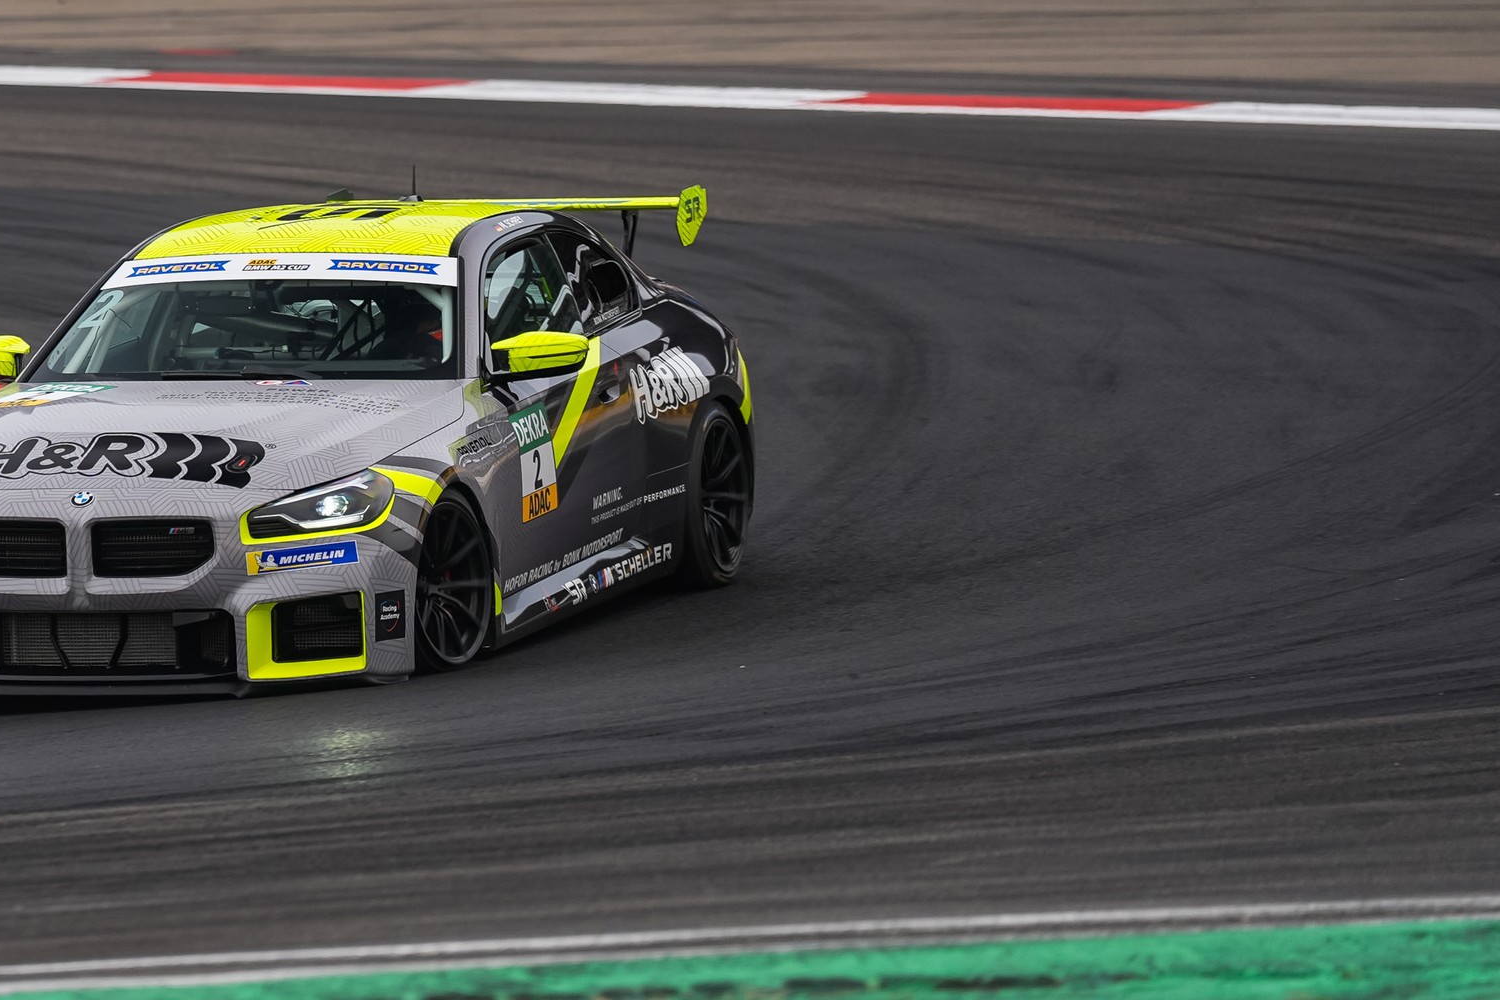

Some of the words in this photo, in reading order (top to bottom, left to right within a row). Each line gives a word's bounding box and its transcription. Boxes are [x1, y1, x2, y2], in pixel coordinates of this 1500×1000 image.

[135, 262, 222, 275] RAVENOL
[337, 261, 430, 272] RAVENOL
[630, 356, 689, 424] H&R
[512, 409, 549, 448] DEKRA
[533, 449, 543, 490] 2
[528, 487, 551, 519] ADAC
[279, 549, 345, 565] MICHELIN
[503, 571, 528, 594] HOFOR
[528, 562, 554, 582] RACING
[554, 560, 561, 573] by
[562, 548, 581, 567] BONK
[581, 528, 624, 558] MOTORSPORT
[380, 611, 400, 622] Academy
[382, 603, 397, 614] Racing
